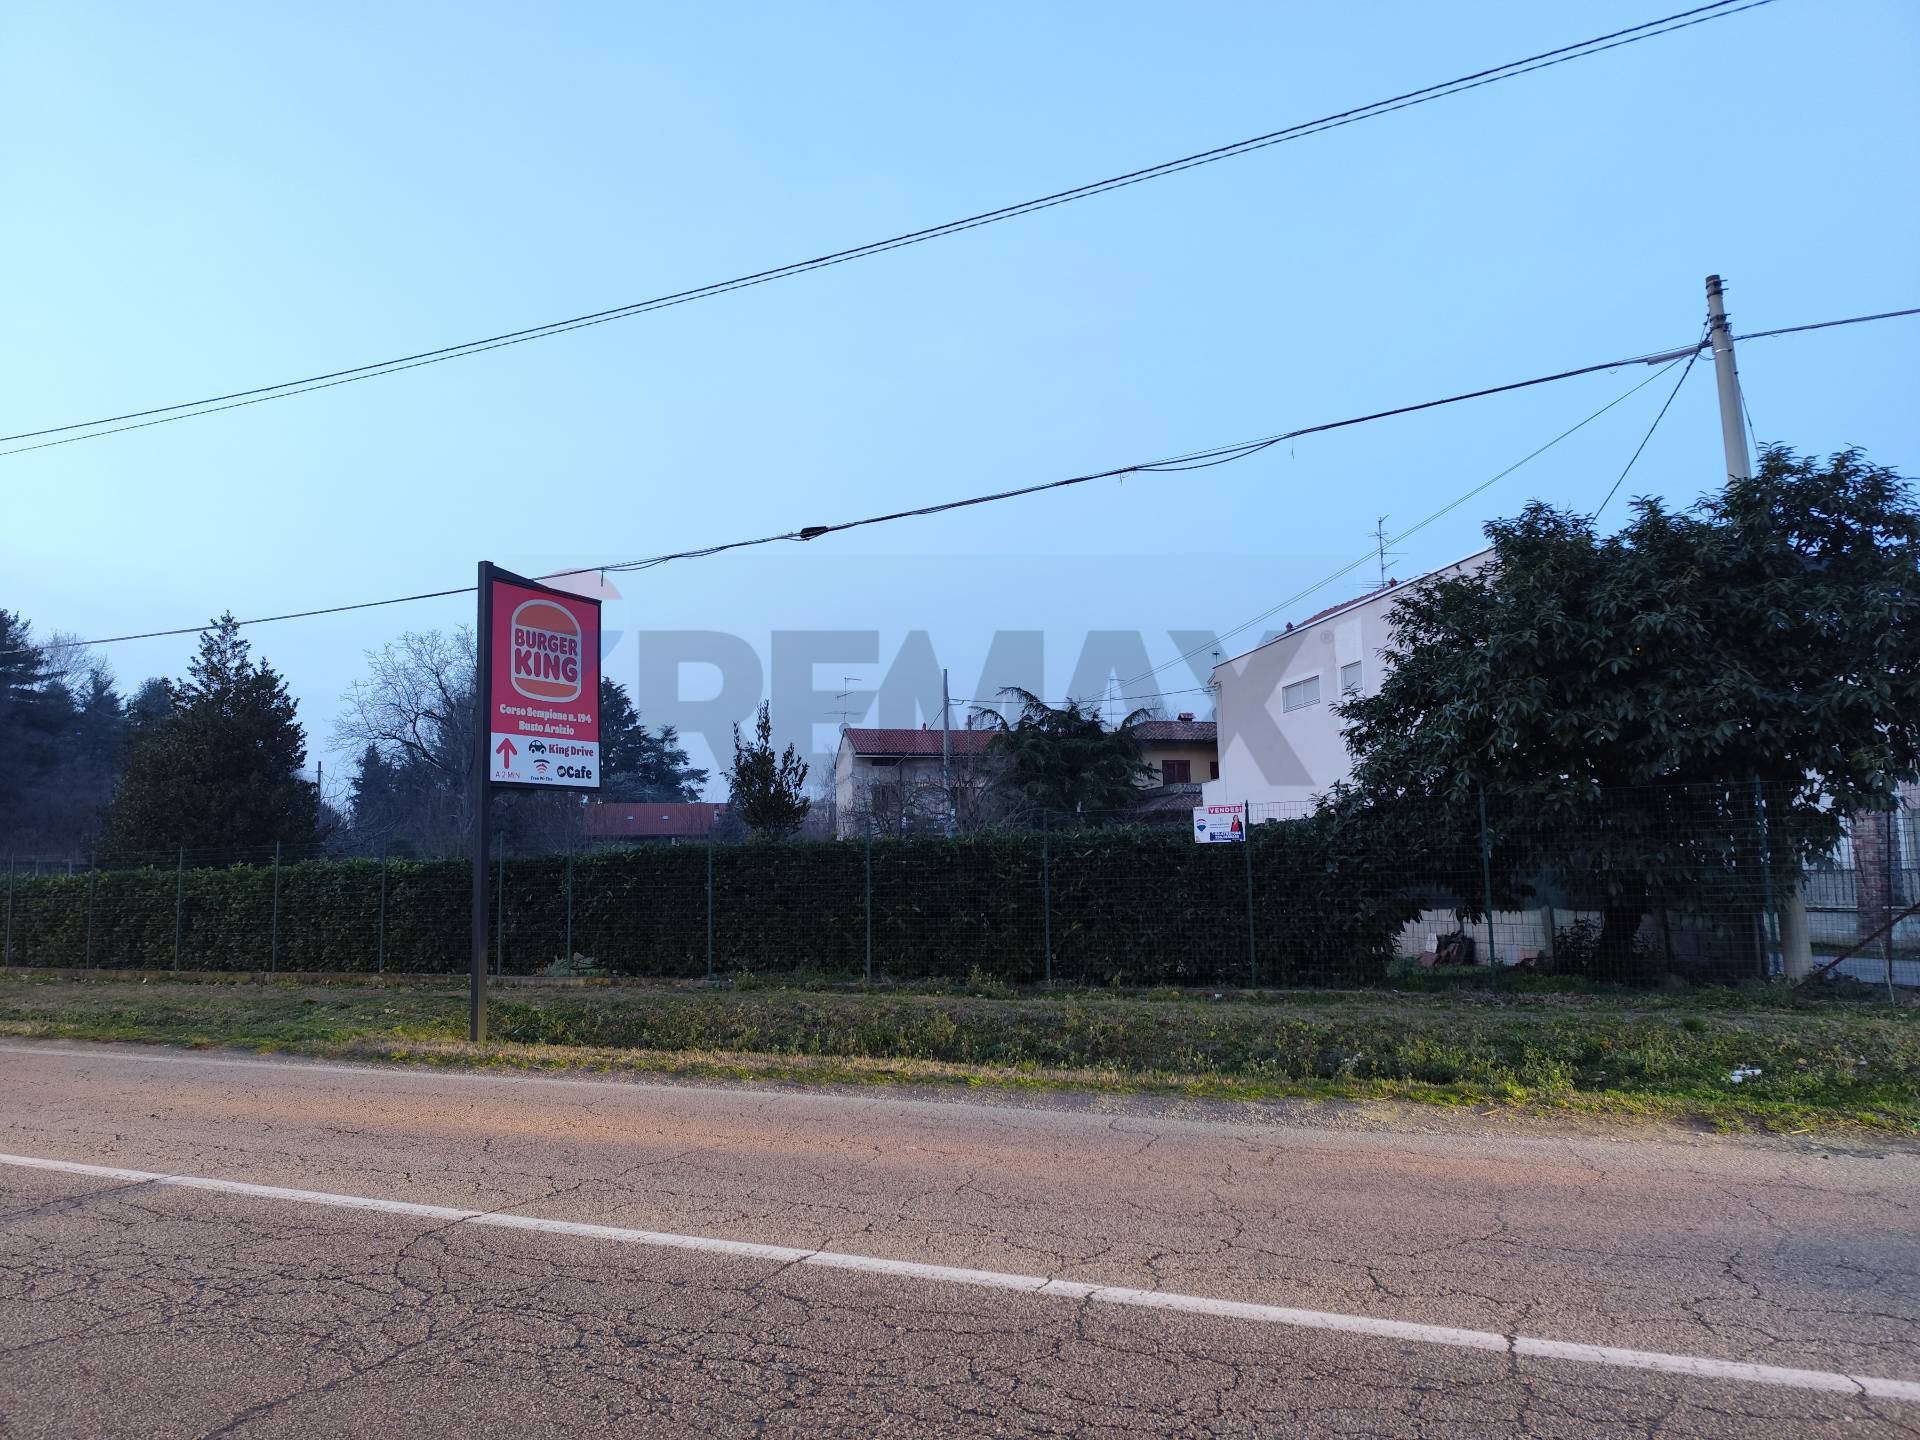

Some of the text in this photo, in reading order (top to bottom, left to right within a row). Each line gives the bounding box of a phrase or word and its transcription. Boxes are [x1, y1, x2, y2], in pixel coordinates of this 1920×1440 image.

[514, 628, 578, 656] BURGER
[514, 648, 578, 682] KING
[500, 704, 526, 715] Corso
[527, 707, 567, 720] Sempione
[577, 714, 592, 723] 194
[519, 720, 544, 732] Busto
[548, 744, 594, 757] King Drive
[1209, 806, 1242, 814] VENDESI
